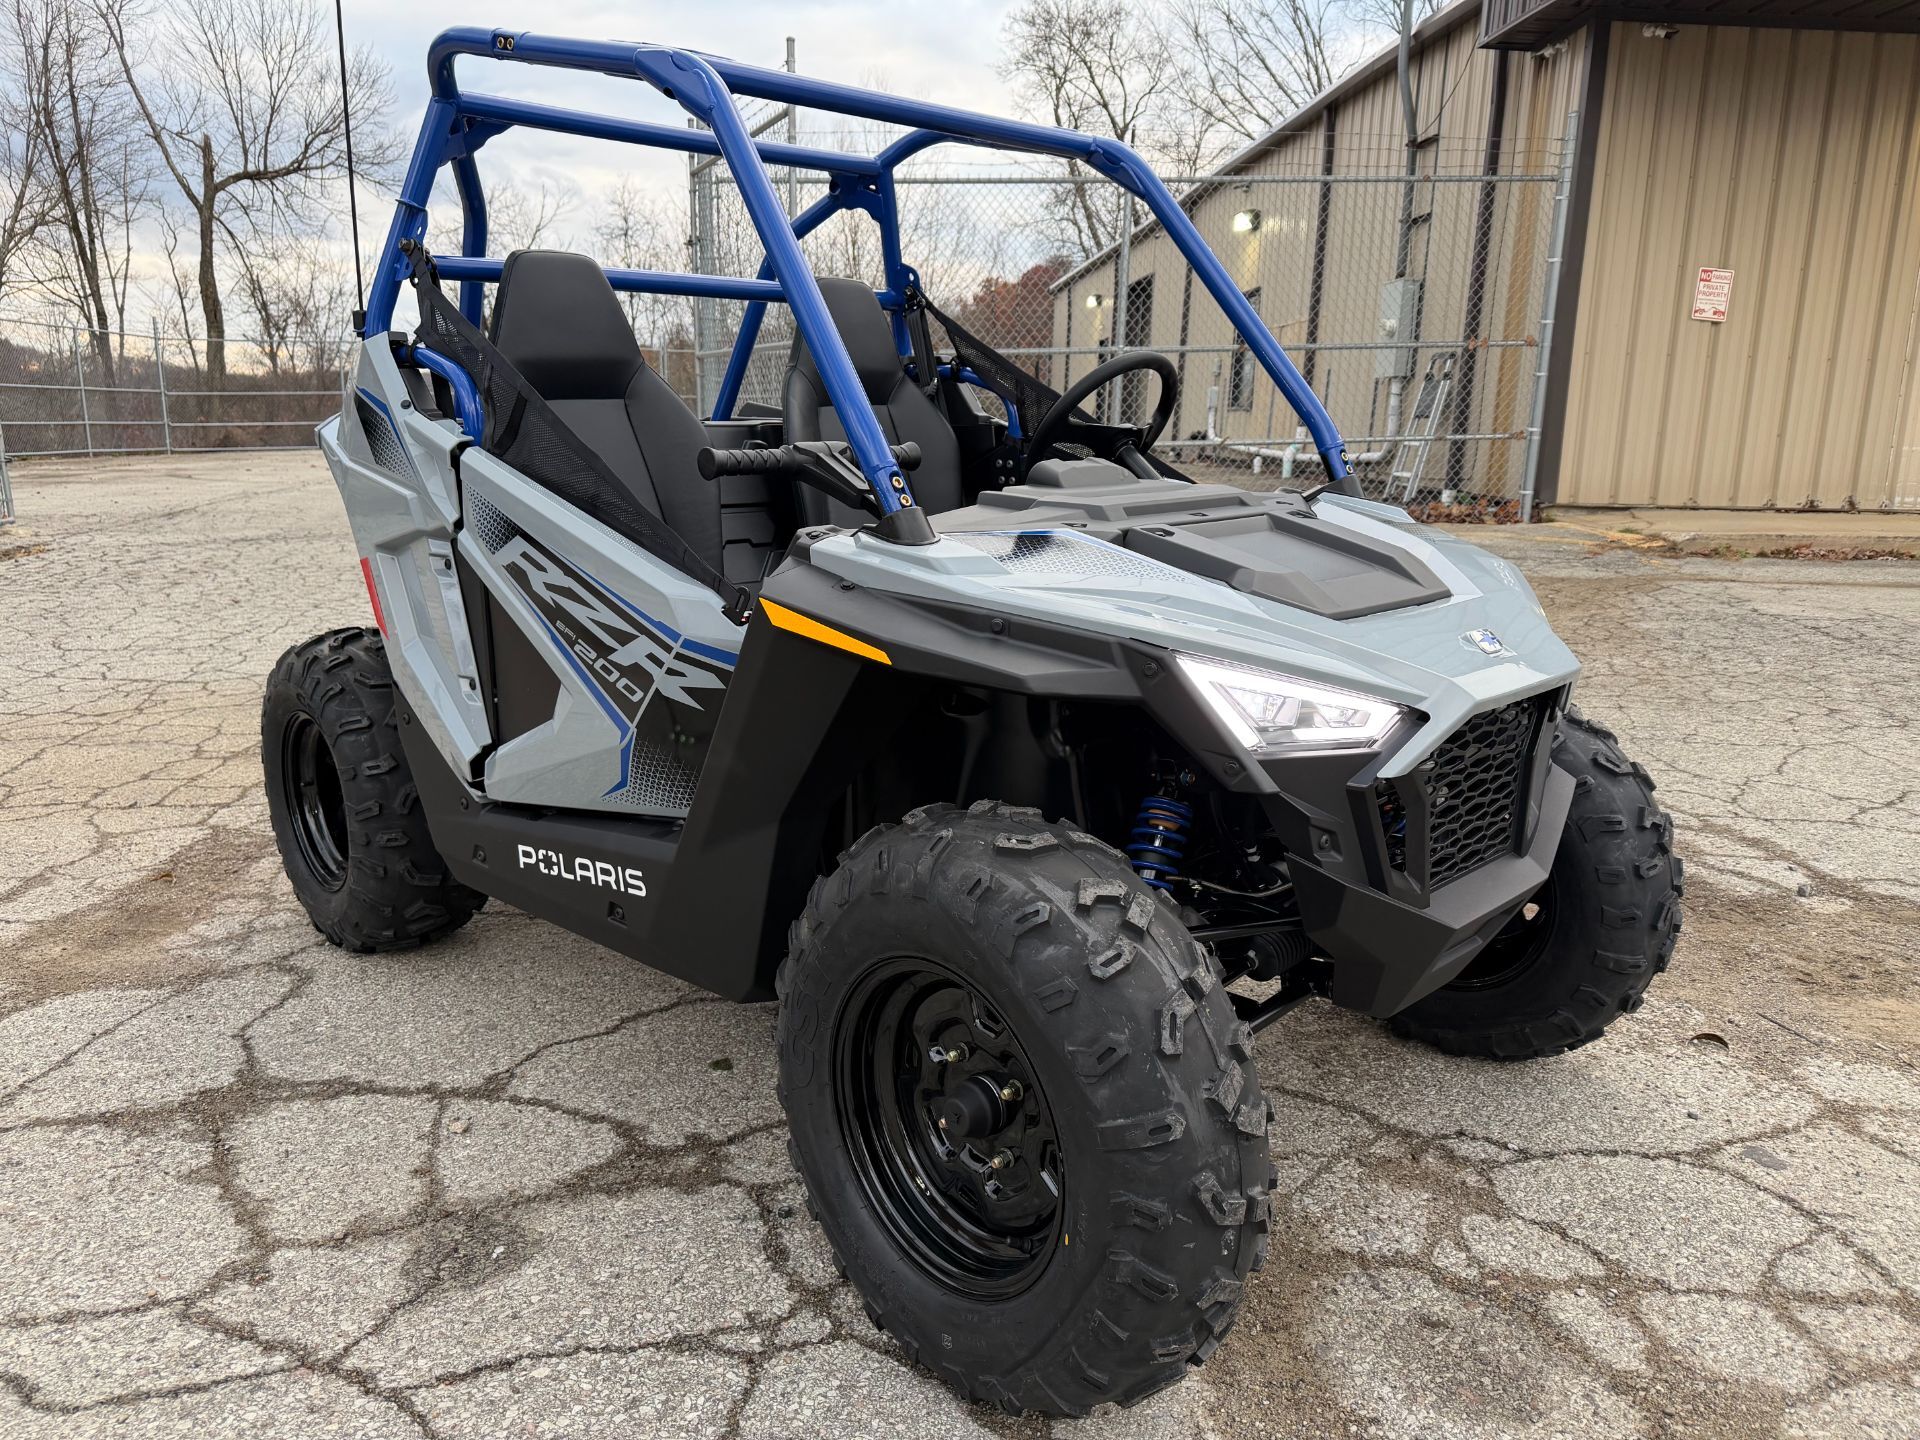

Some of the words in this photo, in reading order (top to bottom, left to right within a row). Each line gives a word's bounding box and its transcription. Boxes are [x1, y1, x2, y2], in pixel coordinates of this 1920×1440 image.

[1698, 291, 1727, 299] PROPERTY
[1701, 272, 1712, 280] NO
[1713, 273, 1731, 281] PARKING
[495, 535, 727, 711] RZR
[555, 620, 576, 641] EFI
[574, 638, 645, 703] 200
[517, 844, 647, 897] POLARIS
